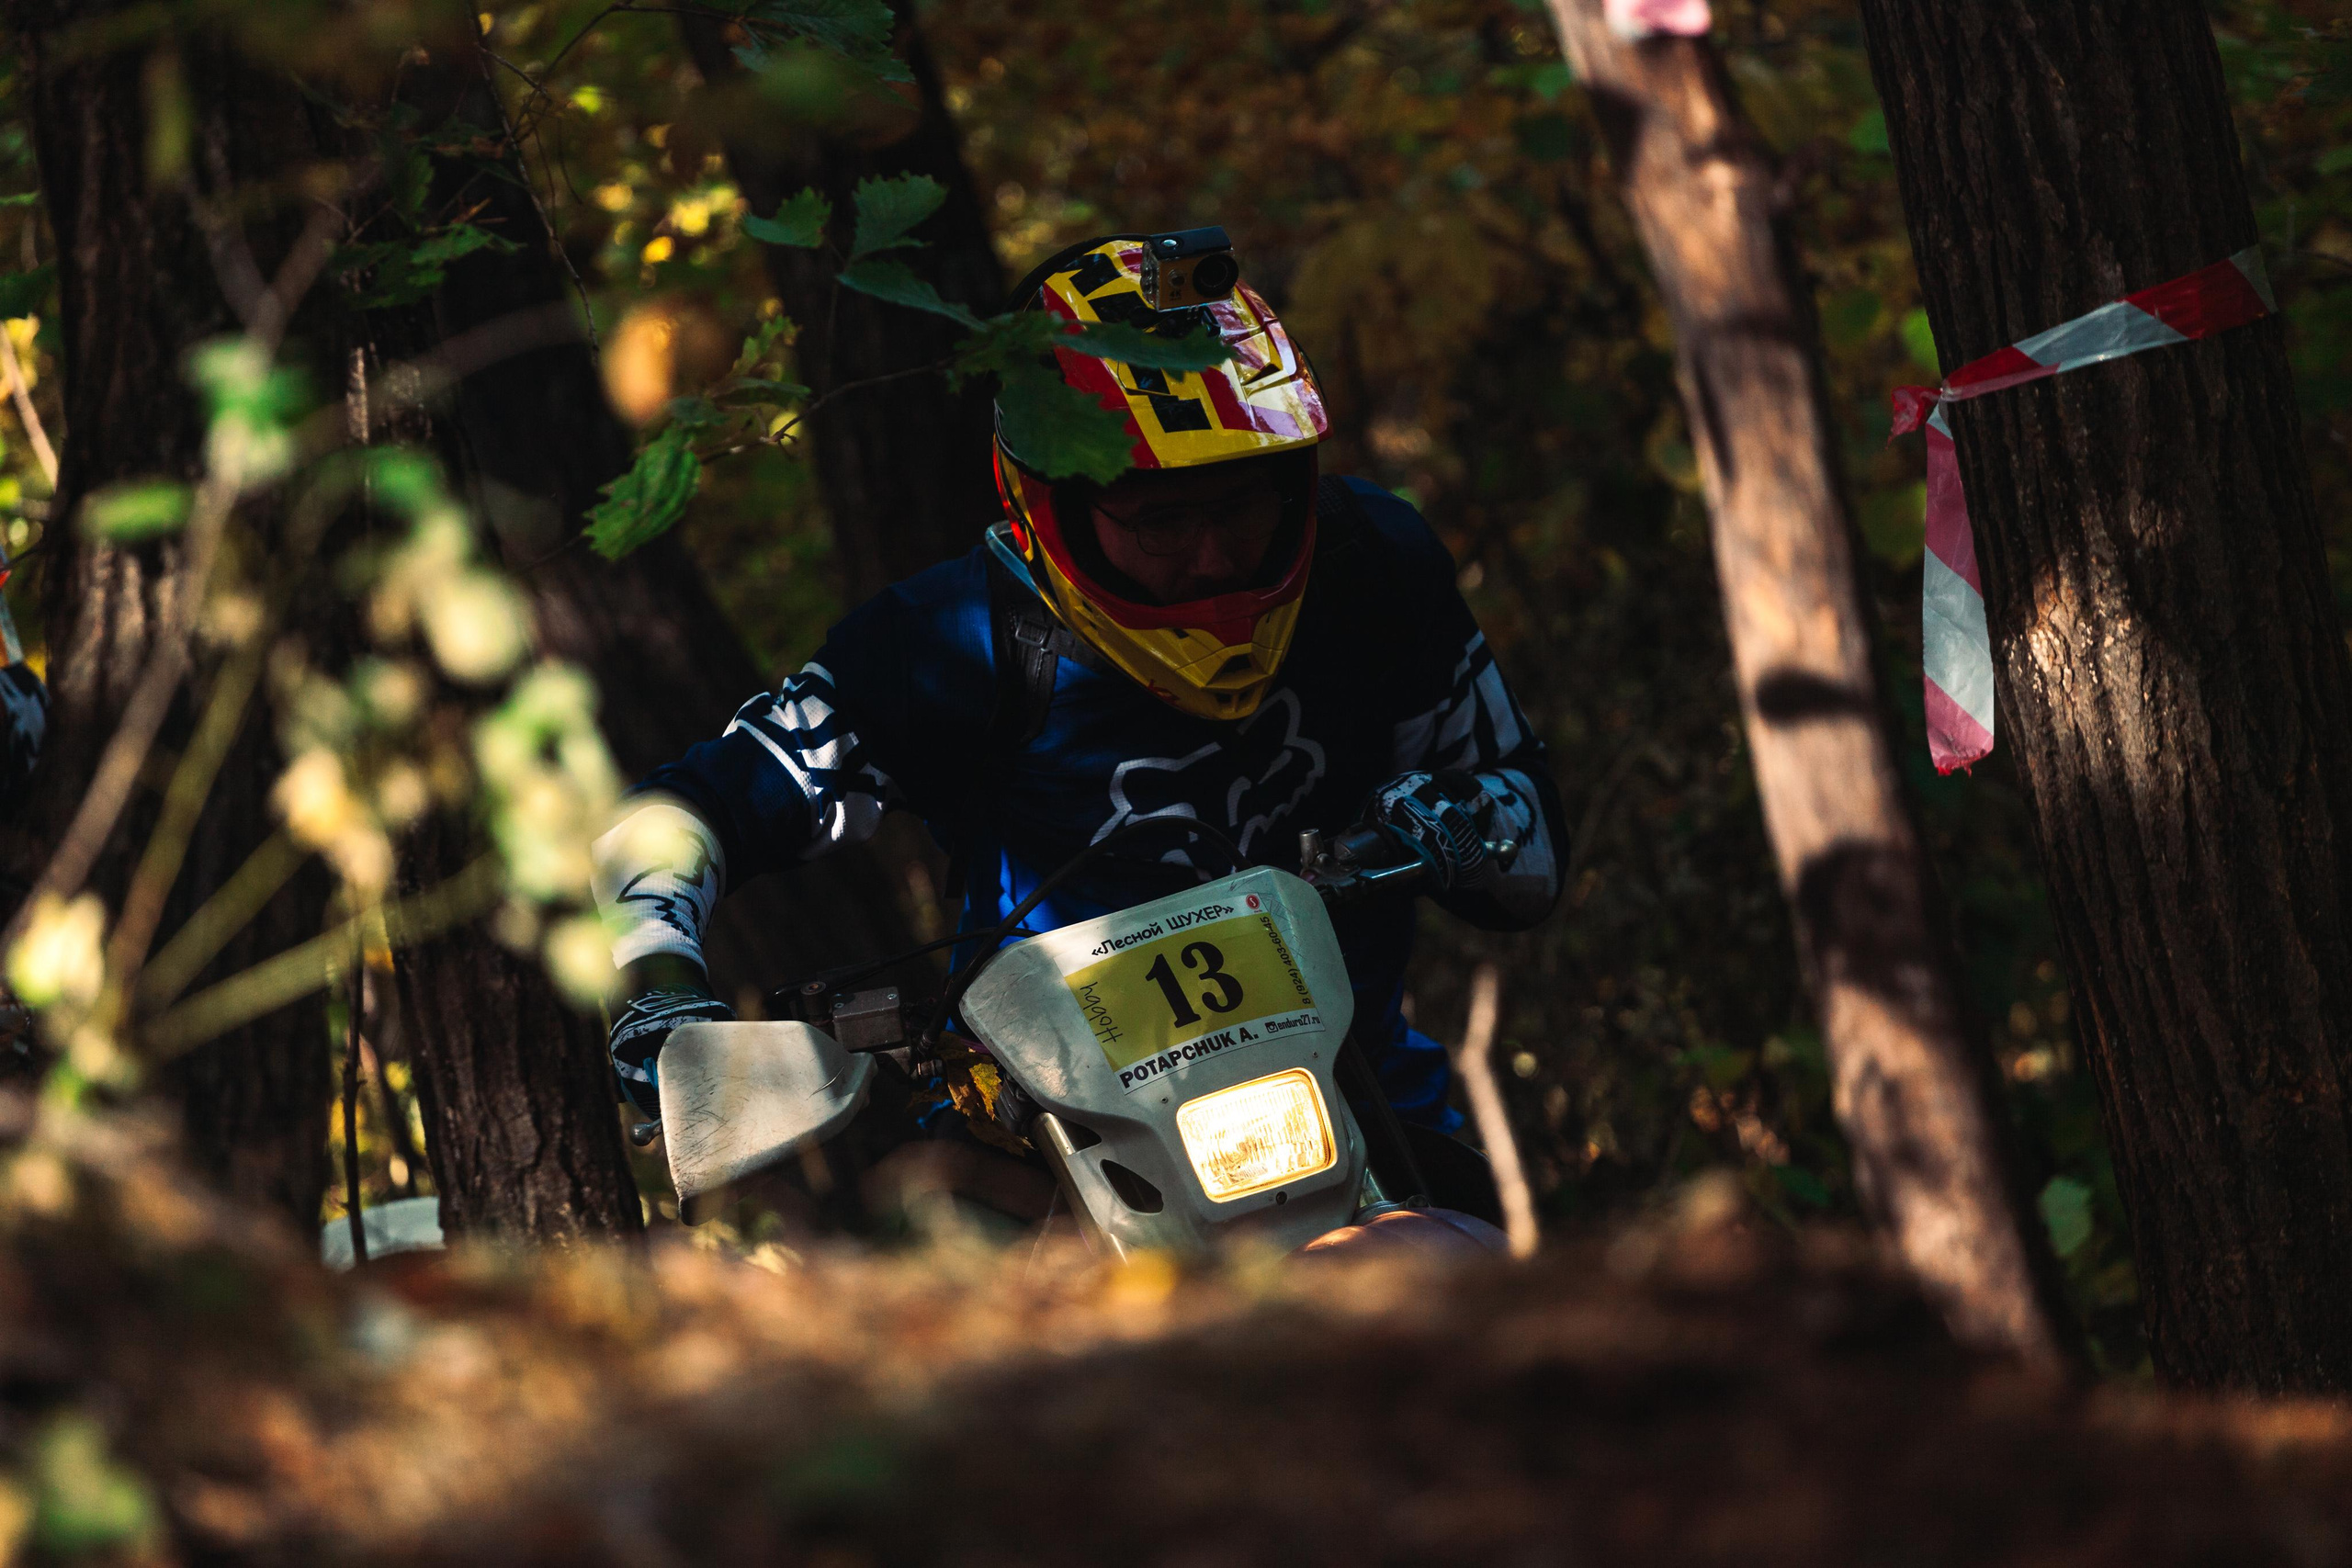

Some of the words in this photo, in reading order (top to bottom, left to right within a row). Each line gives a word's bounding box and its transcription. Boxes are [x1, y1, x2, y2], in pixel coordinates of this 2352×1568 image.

[1091, 921, 1164, 956] «Лесной
[1165, 905, 1234, 931] ШУХЕР»
[1260, 916, 1293, 967] 403-60-45
[1145, 941, 1244, 1029] 13
[1288, 968, 1308, 996] (924)
[1080, 981, 1123, 1044] Hobby
[1278, 1014, 1320, 1030] enduro27.ru
[1119, 1034, 1238, 1089] POTAPCHUK
[1239, 1026, 1260, 1043] A.
